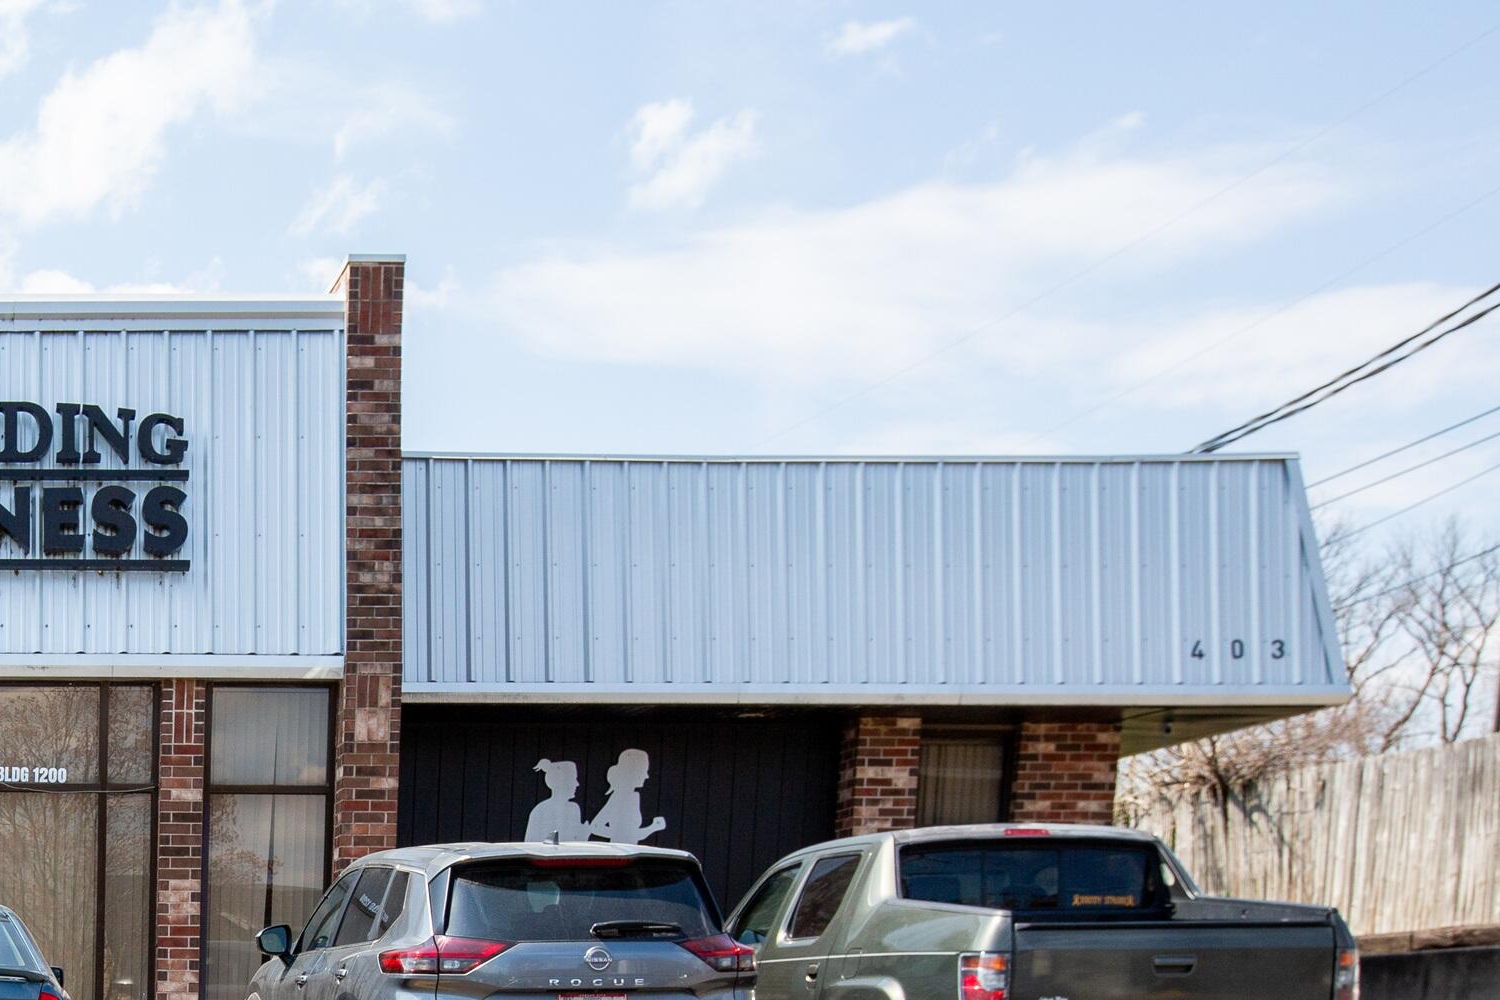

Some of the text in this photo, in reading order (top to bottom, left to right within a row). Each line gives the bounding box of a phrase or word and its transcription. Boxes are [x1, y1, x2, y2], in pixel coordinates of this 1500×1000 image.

[1190, 639, 1286, 660] 403
[32, 767, 67, 784] 1200
[549, 978, 645, 987] ROGUE
